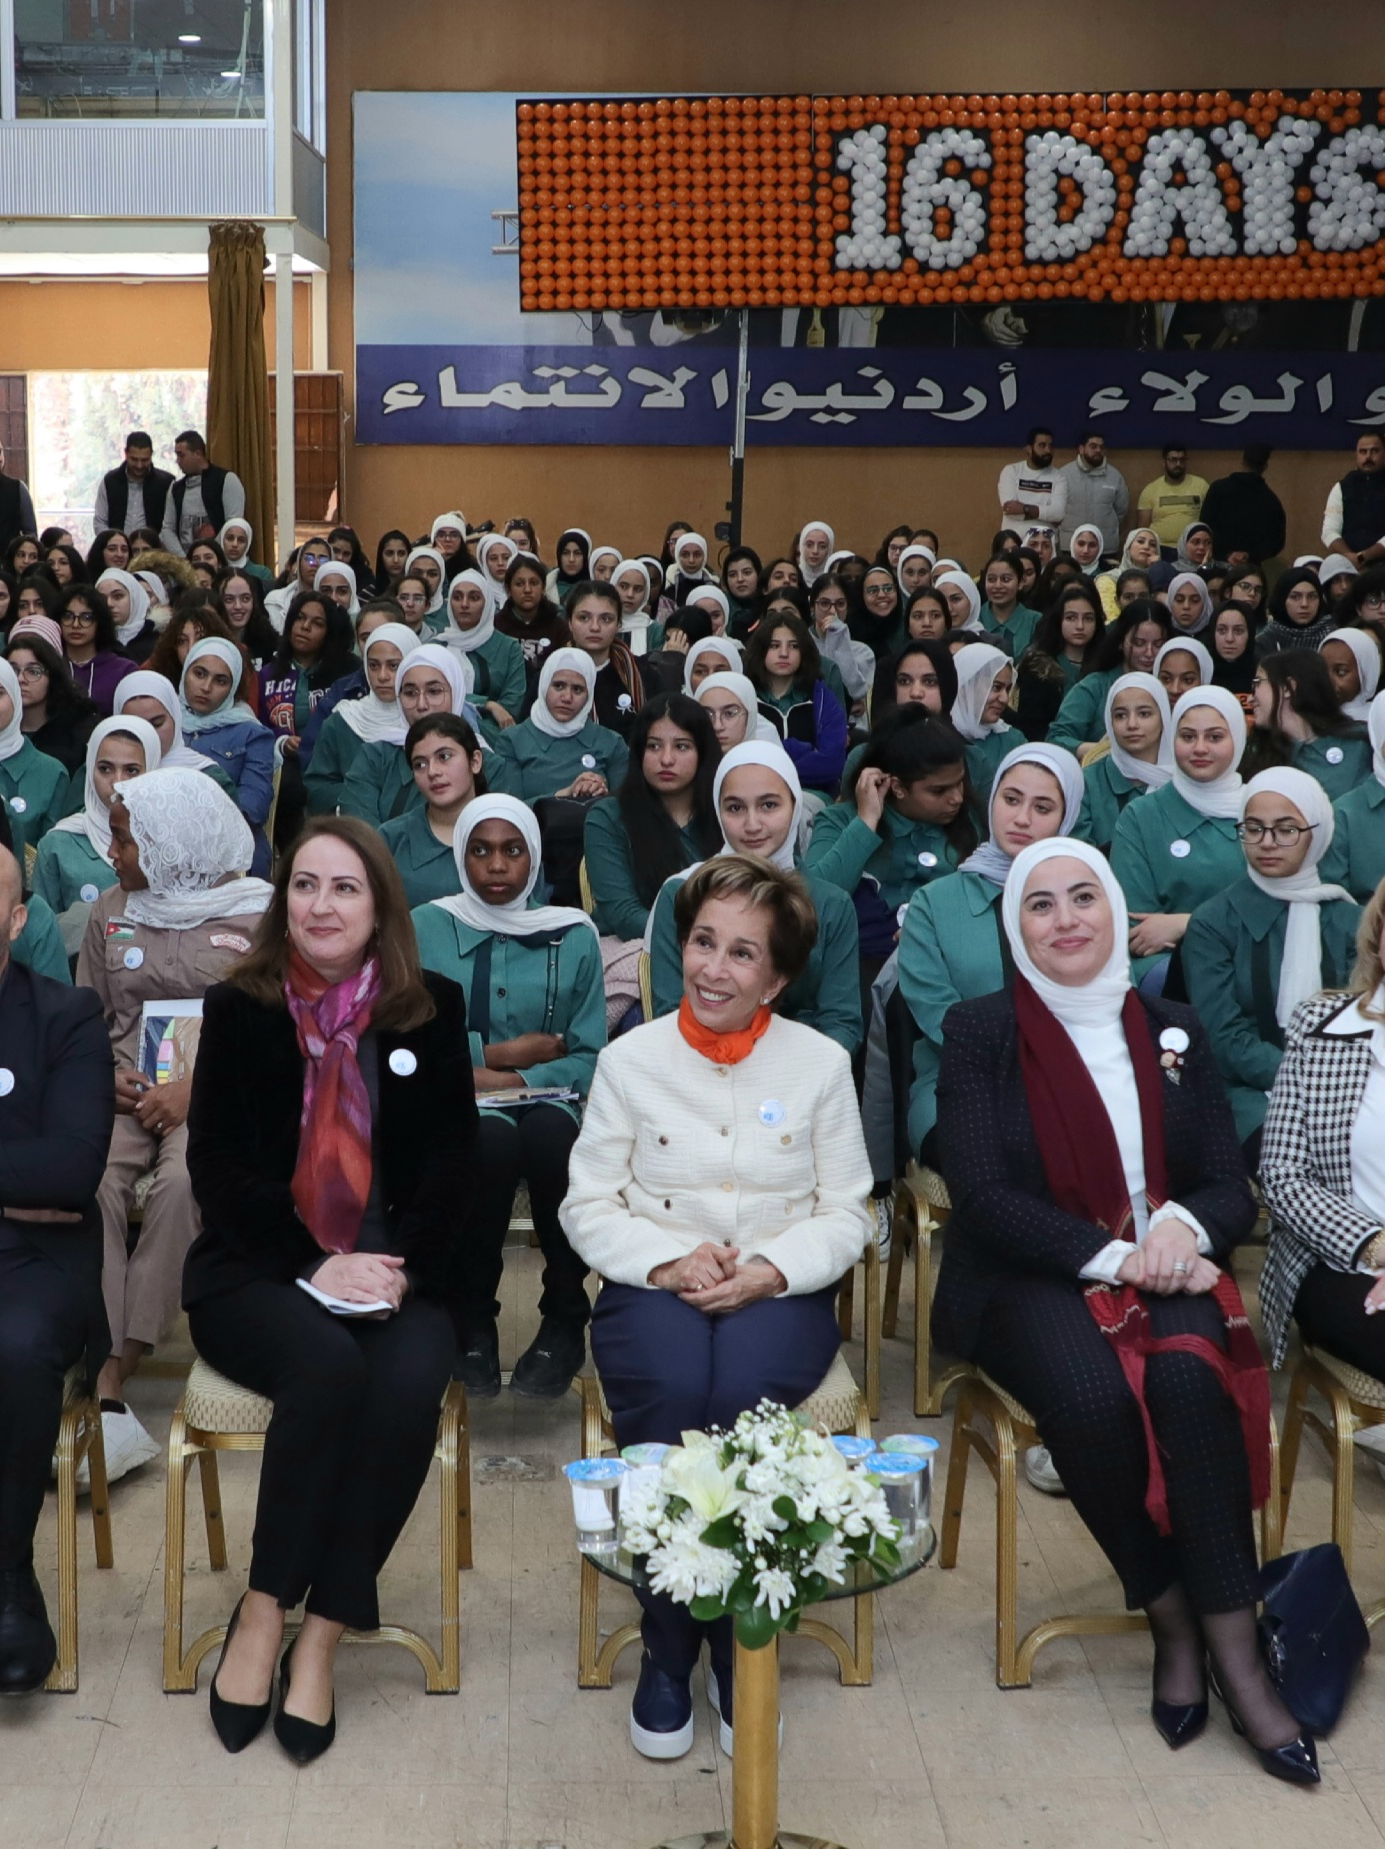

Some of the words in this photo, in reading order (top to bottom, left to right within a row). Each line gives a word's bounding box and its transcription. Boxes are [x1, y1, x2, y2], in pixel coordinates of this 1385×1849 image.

[834, 124, 991, 270] 16
[383, 363, 729, 415] الانتماء
[745, 361, 1018, 425] أردنيو
[1088, 370, 1334, 425] الولاء
